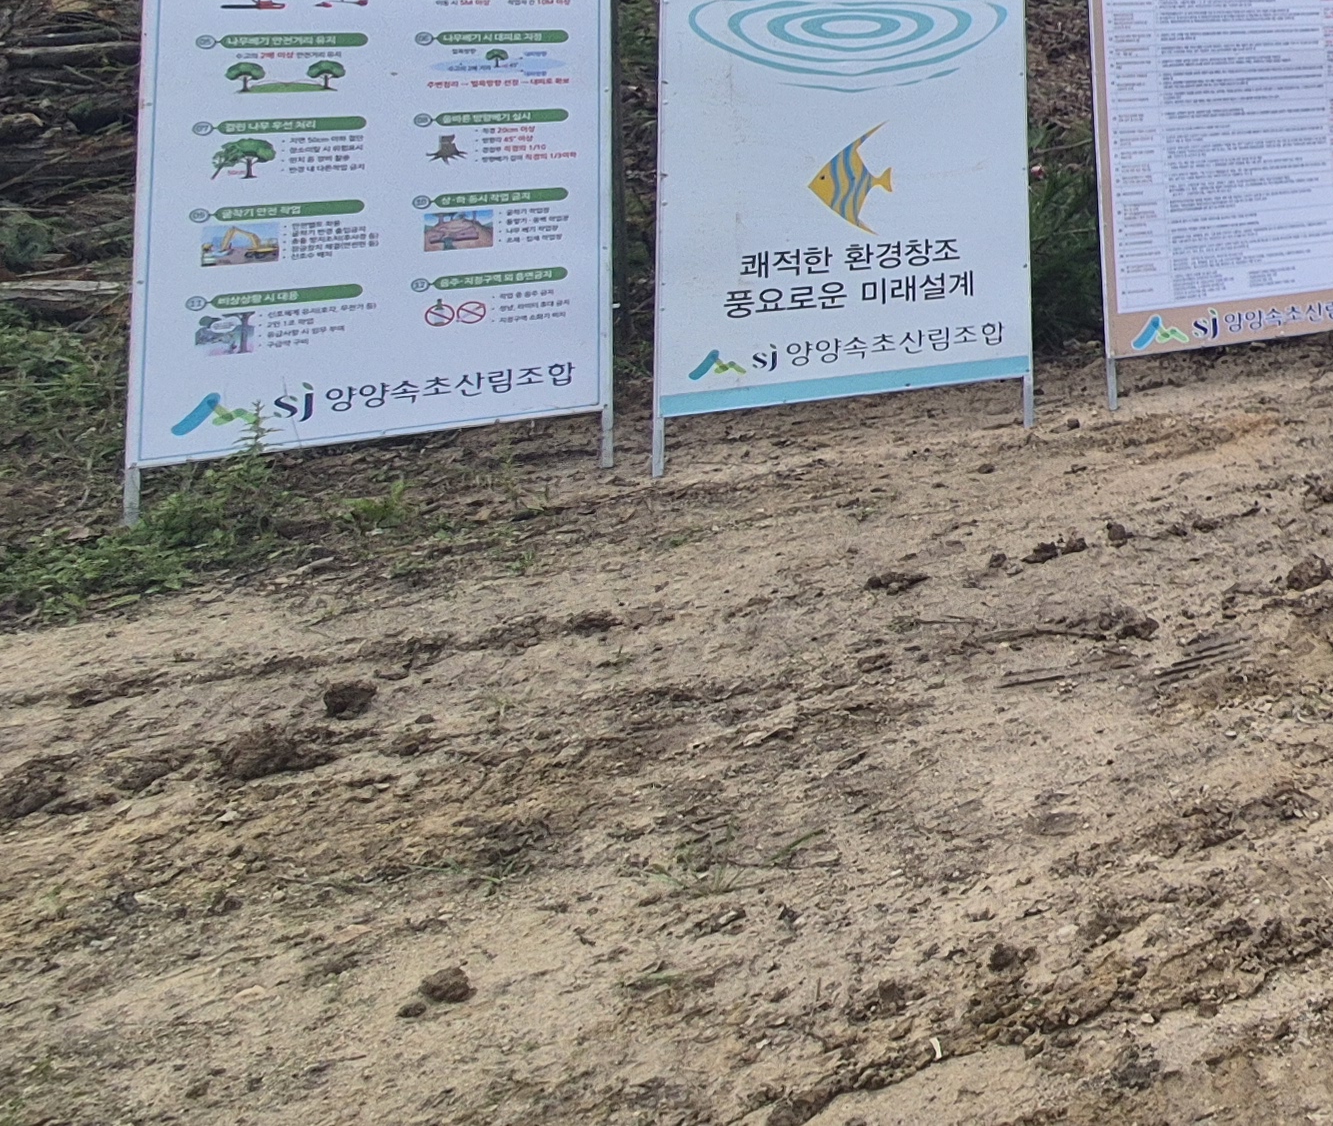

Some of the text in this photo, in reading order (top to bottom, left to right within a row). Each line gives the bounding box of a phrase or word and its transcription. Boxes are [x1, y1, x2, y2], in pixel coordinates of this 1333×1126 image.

[739, 237, 961, 278] 쾌적한 환경창조
[723, 270, 975, 319] 풍요로운 미래설계
[751, 321, 1005, 372] sj 양양속초산림조합
[273, 361, 576, 422] sj 양양속초산림조합
